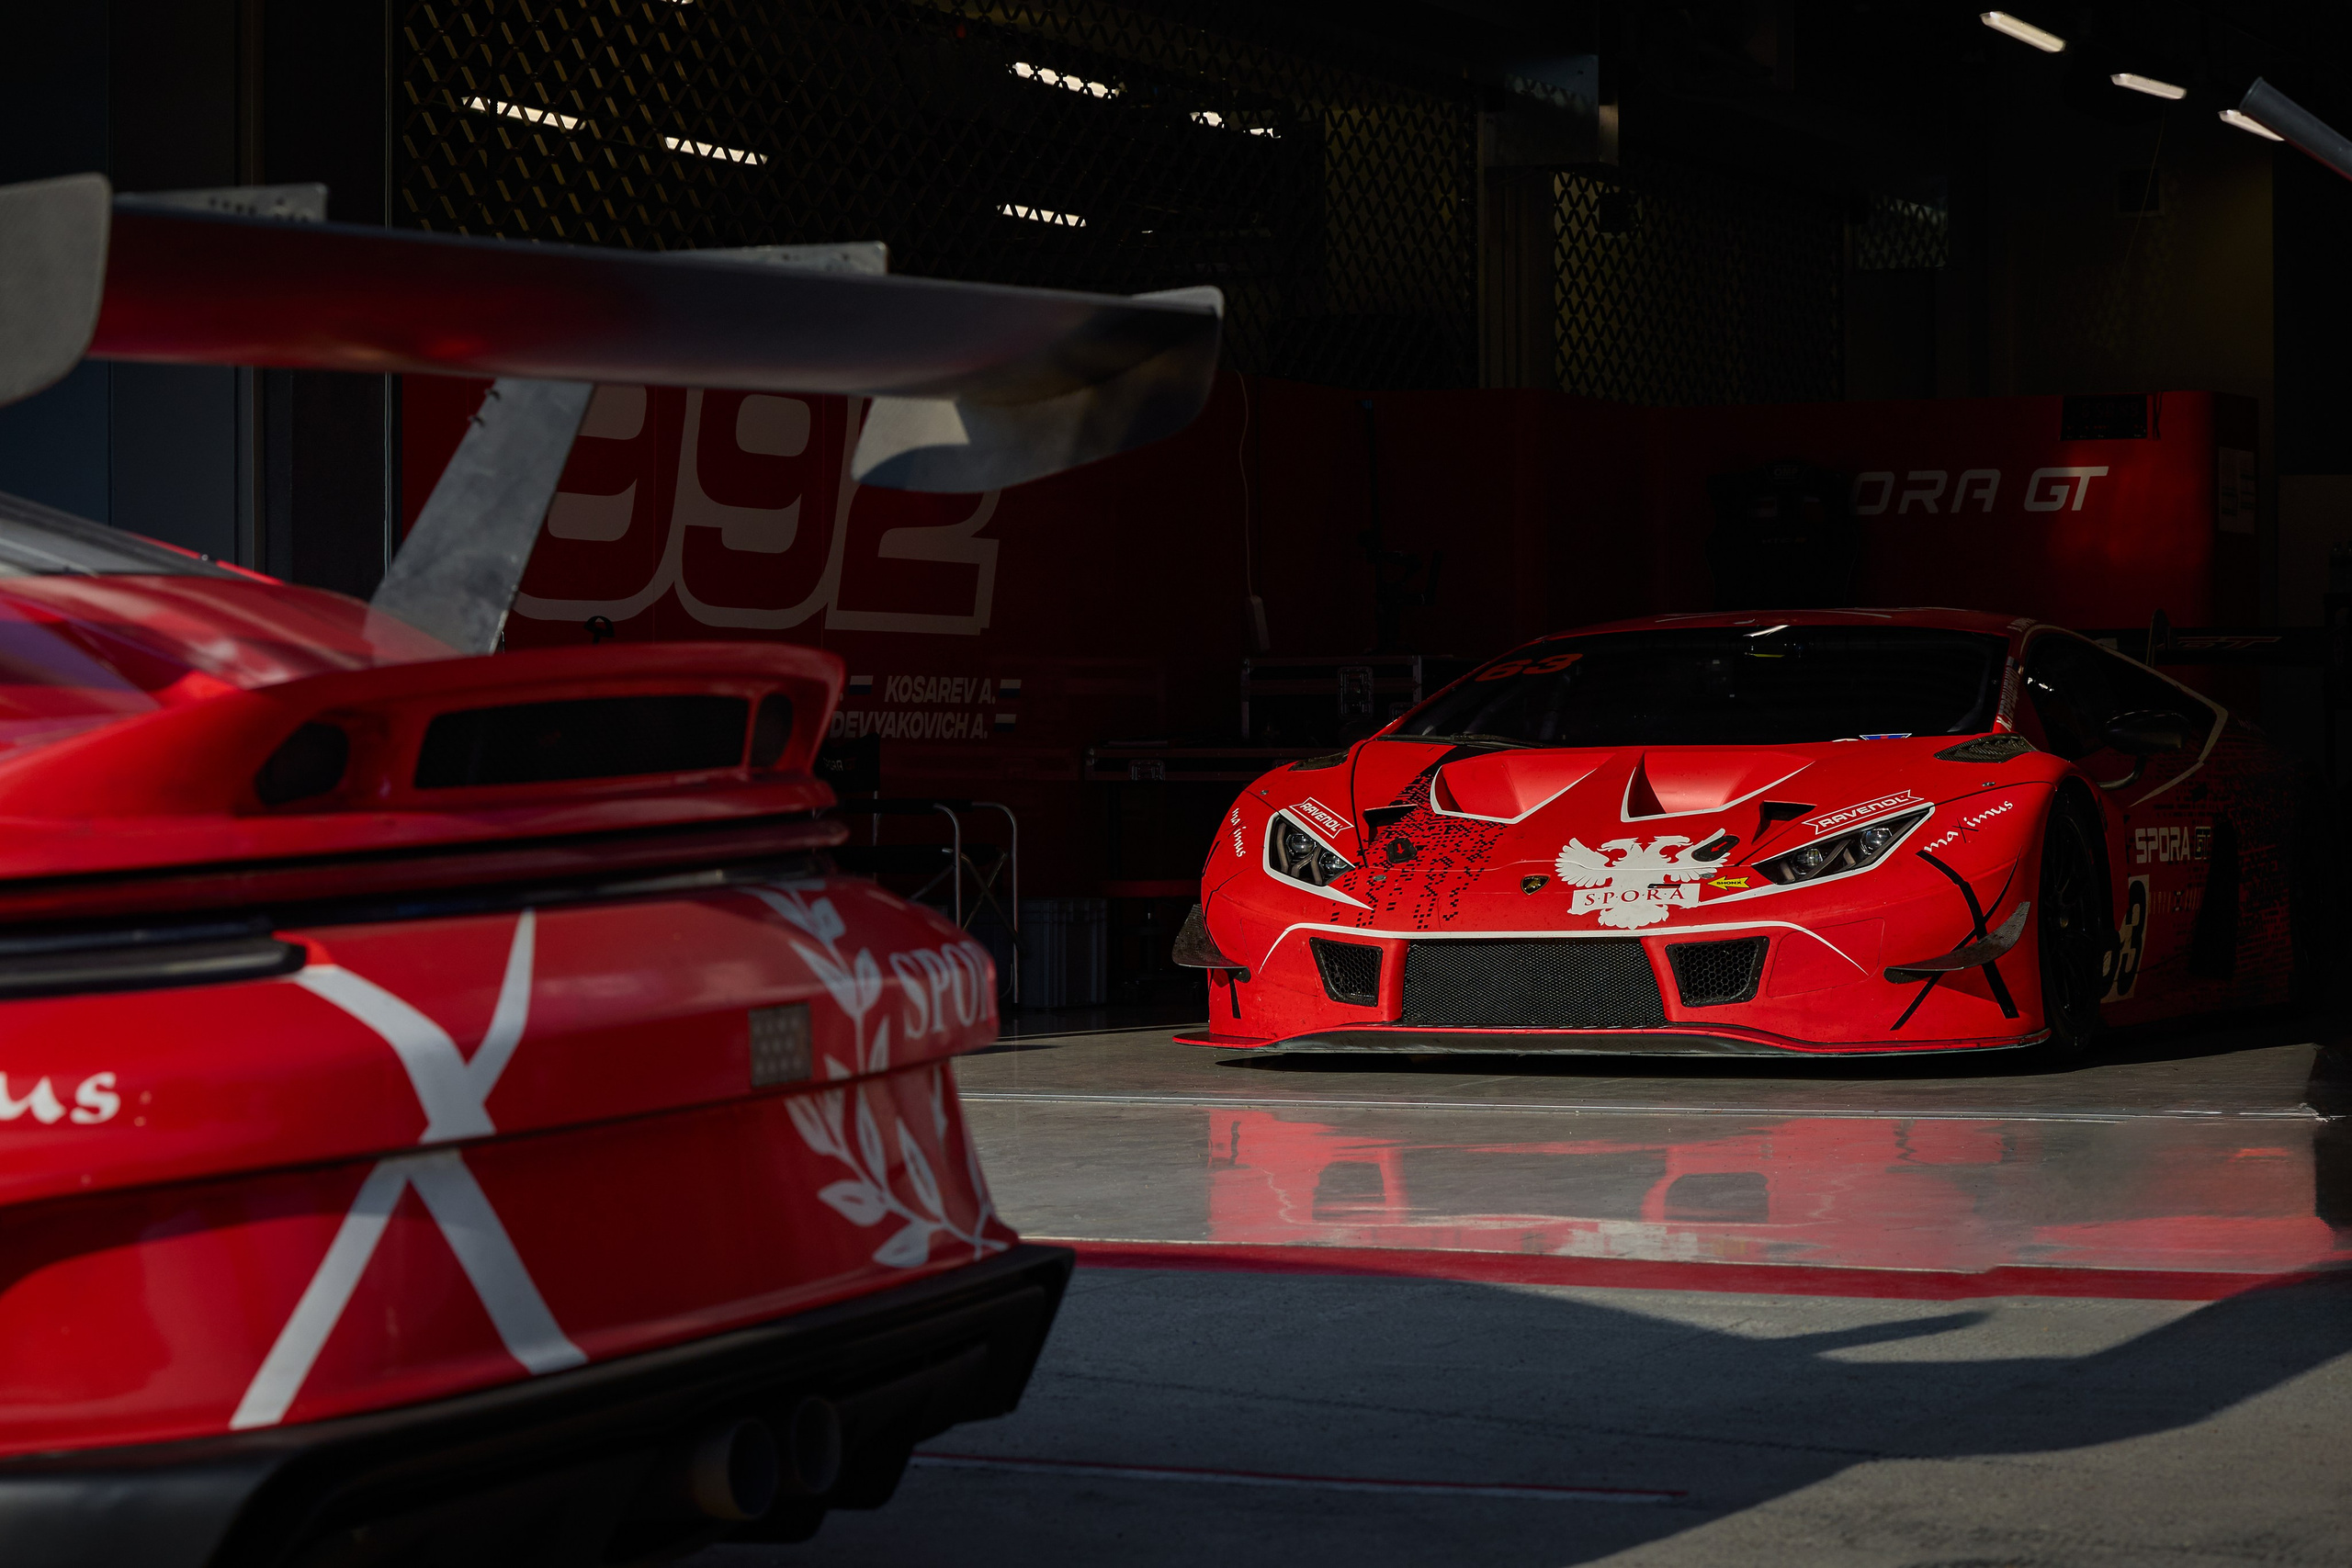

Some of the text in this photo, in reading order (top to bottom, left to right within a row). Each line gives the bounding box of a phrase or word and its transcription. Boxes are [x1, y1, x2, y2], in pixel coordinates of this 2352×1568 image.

[1849, 466, 2109, 516] ORA GT
[1474, 653, 1584, 682] 63
[884, 675, 997, 705] KOSAREV A.
[830, 710, 989, 740] DEVYAKOVICH A.
[1299, 802, 1341, 832] RAVENOL
[1818, 795, 1907, 828] RAVENOL
[2134, 827, 2191, 863] SPORA
